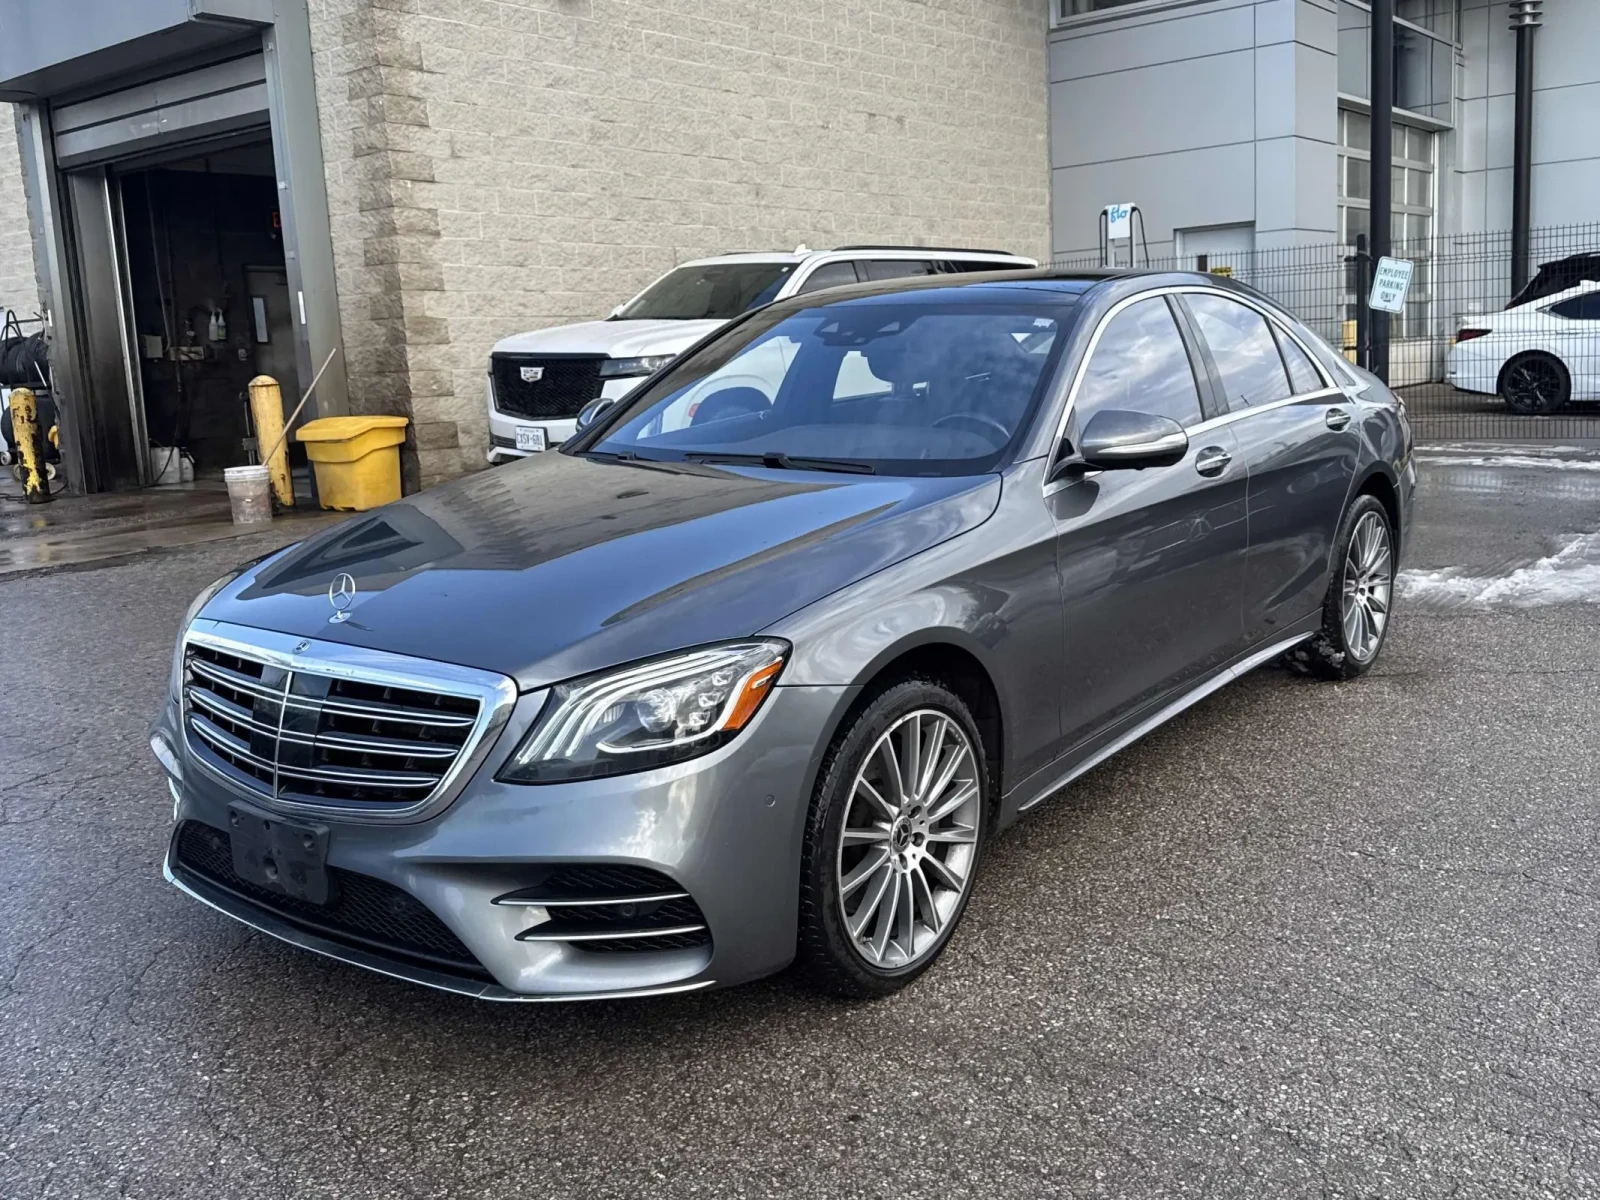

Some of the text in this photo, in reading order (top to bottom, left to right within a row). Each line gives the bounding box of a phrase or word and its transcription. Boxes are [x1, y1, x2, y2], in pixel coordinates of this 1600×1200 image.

[1379, 267, 1408, 279] EMPLOYEE
[1379, 279, 1404, 291] PARKING
[1380, 291, 1396, 301] ONLY
